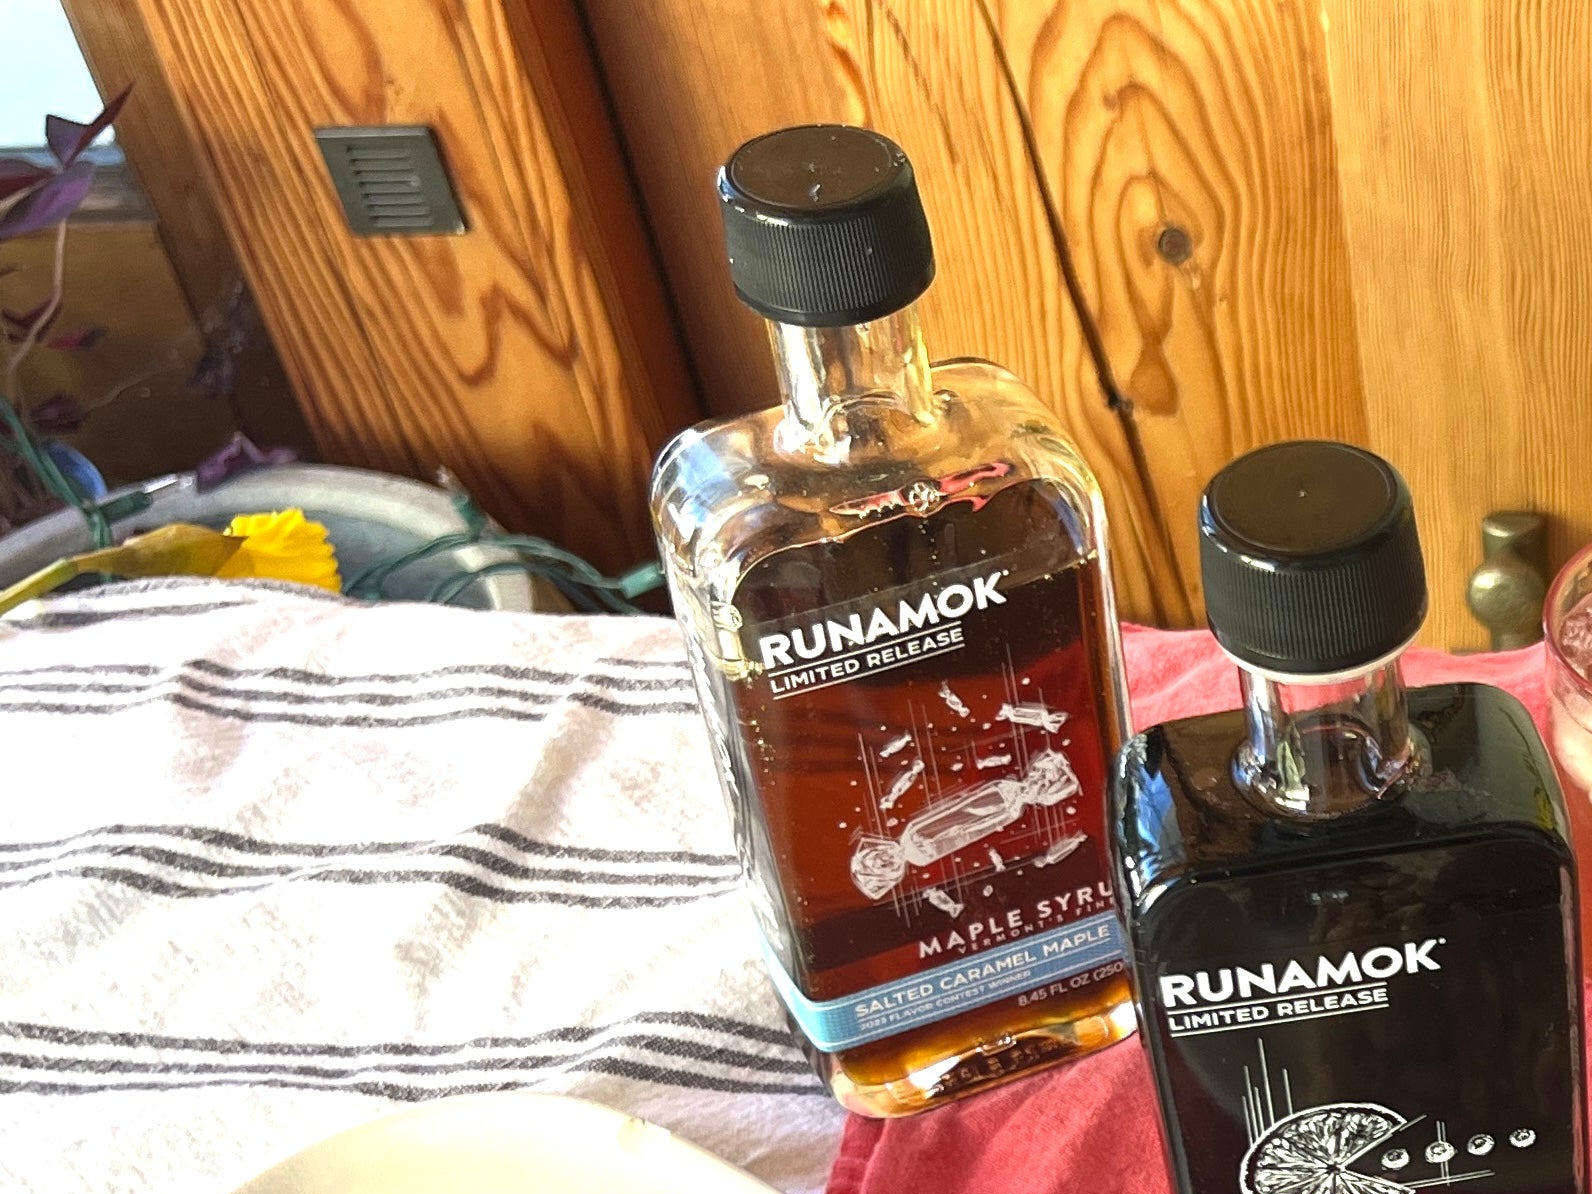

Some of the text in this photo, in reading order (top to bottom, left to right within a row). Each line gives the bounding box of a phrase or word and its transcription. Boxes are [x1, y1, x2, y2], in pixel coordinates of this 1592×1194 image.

[759, 572, 1007, 669] RUNAMOK
[770, 627, 965, 694] LIMITED RELEASE
[919, 881, 1113, 959] MAPLE SYRU
[1075, 898, 1114, 916] FIN
[854, 925, 1112, 1018] SALTED CARAMEL MAPLE
[889, 1003, 933, 1022] FLAVOR
[935, 985, 985, 1007] CONTEST
[989, 970, 1032, 990] WINNER
[1018, 961, 1124, 1006] 8.45 FL OZ (250
[1159, 938, 1441, 1008] RUNAMOK
[1168, 988, 1389, 1031] LIMITED RELEASE
